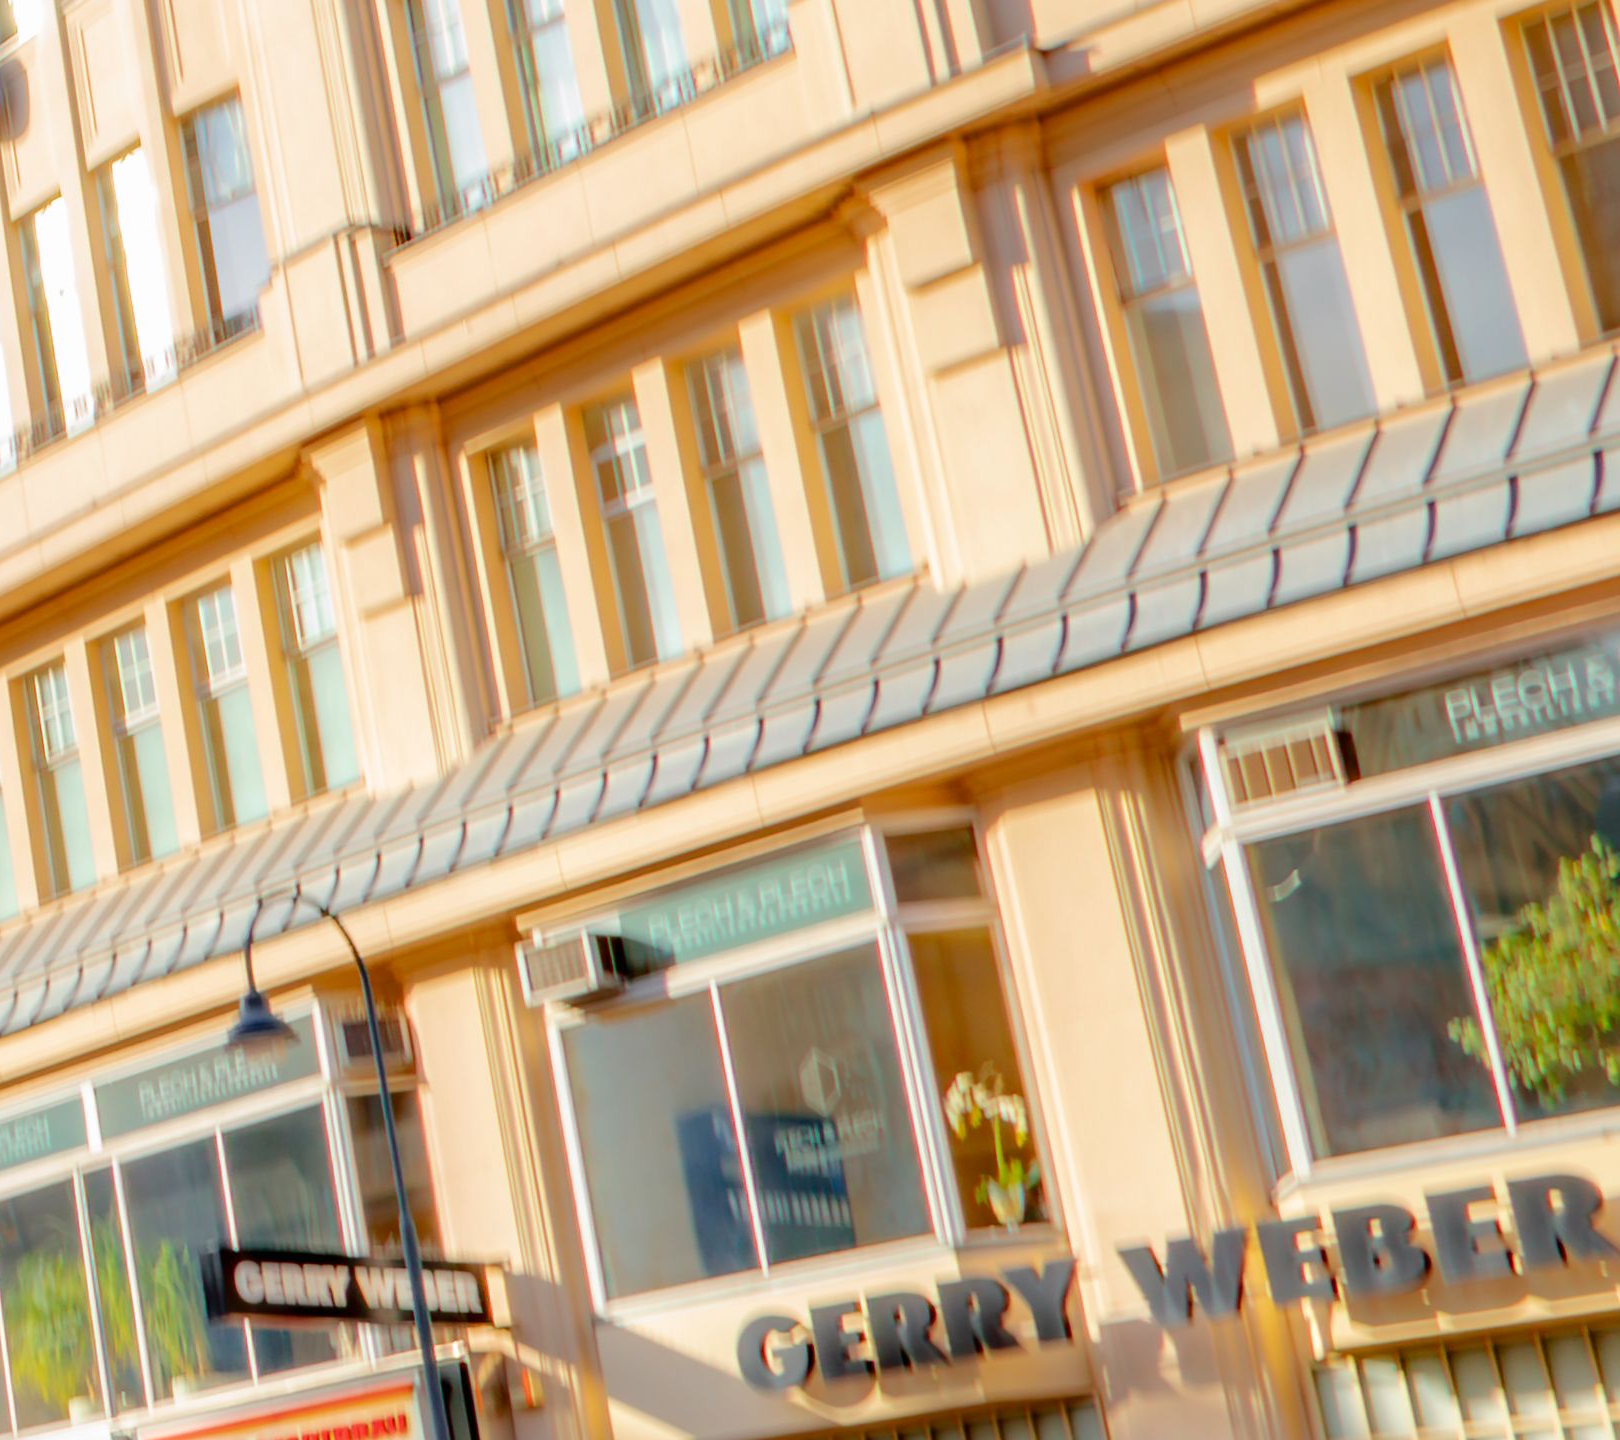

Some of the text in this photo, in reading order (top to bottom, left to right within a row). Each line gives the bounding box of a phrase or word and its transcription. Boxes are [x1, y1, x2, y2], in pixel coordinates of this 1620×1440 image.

[1445, 662, 1581, 743] PLECH
[234, 1260, 350, 1308] GERRY
[737, 1173, 1620, 1393] GERRY WEBER
